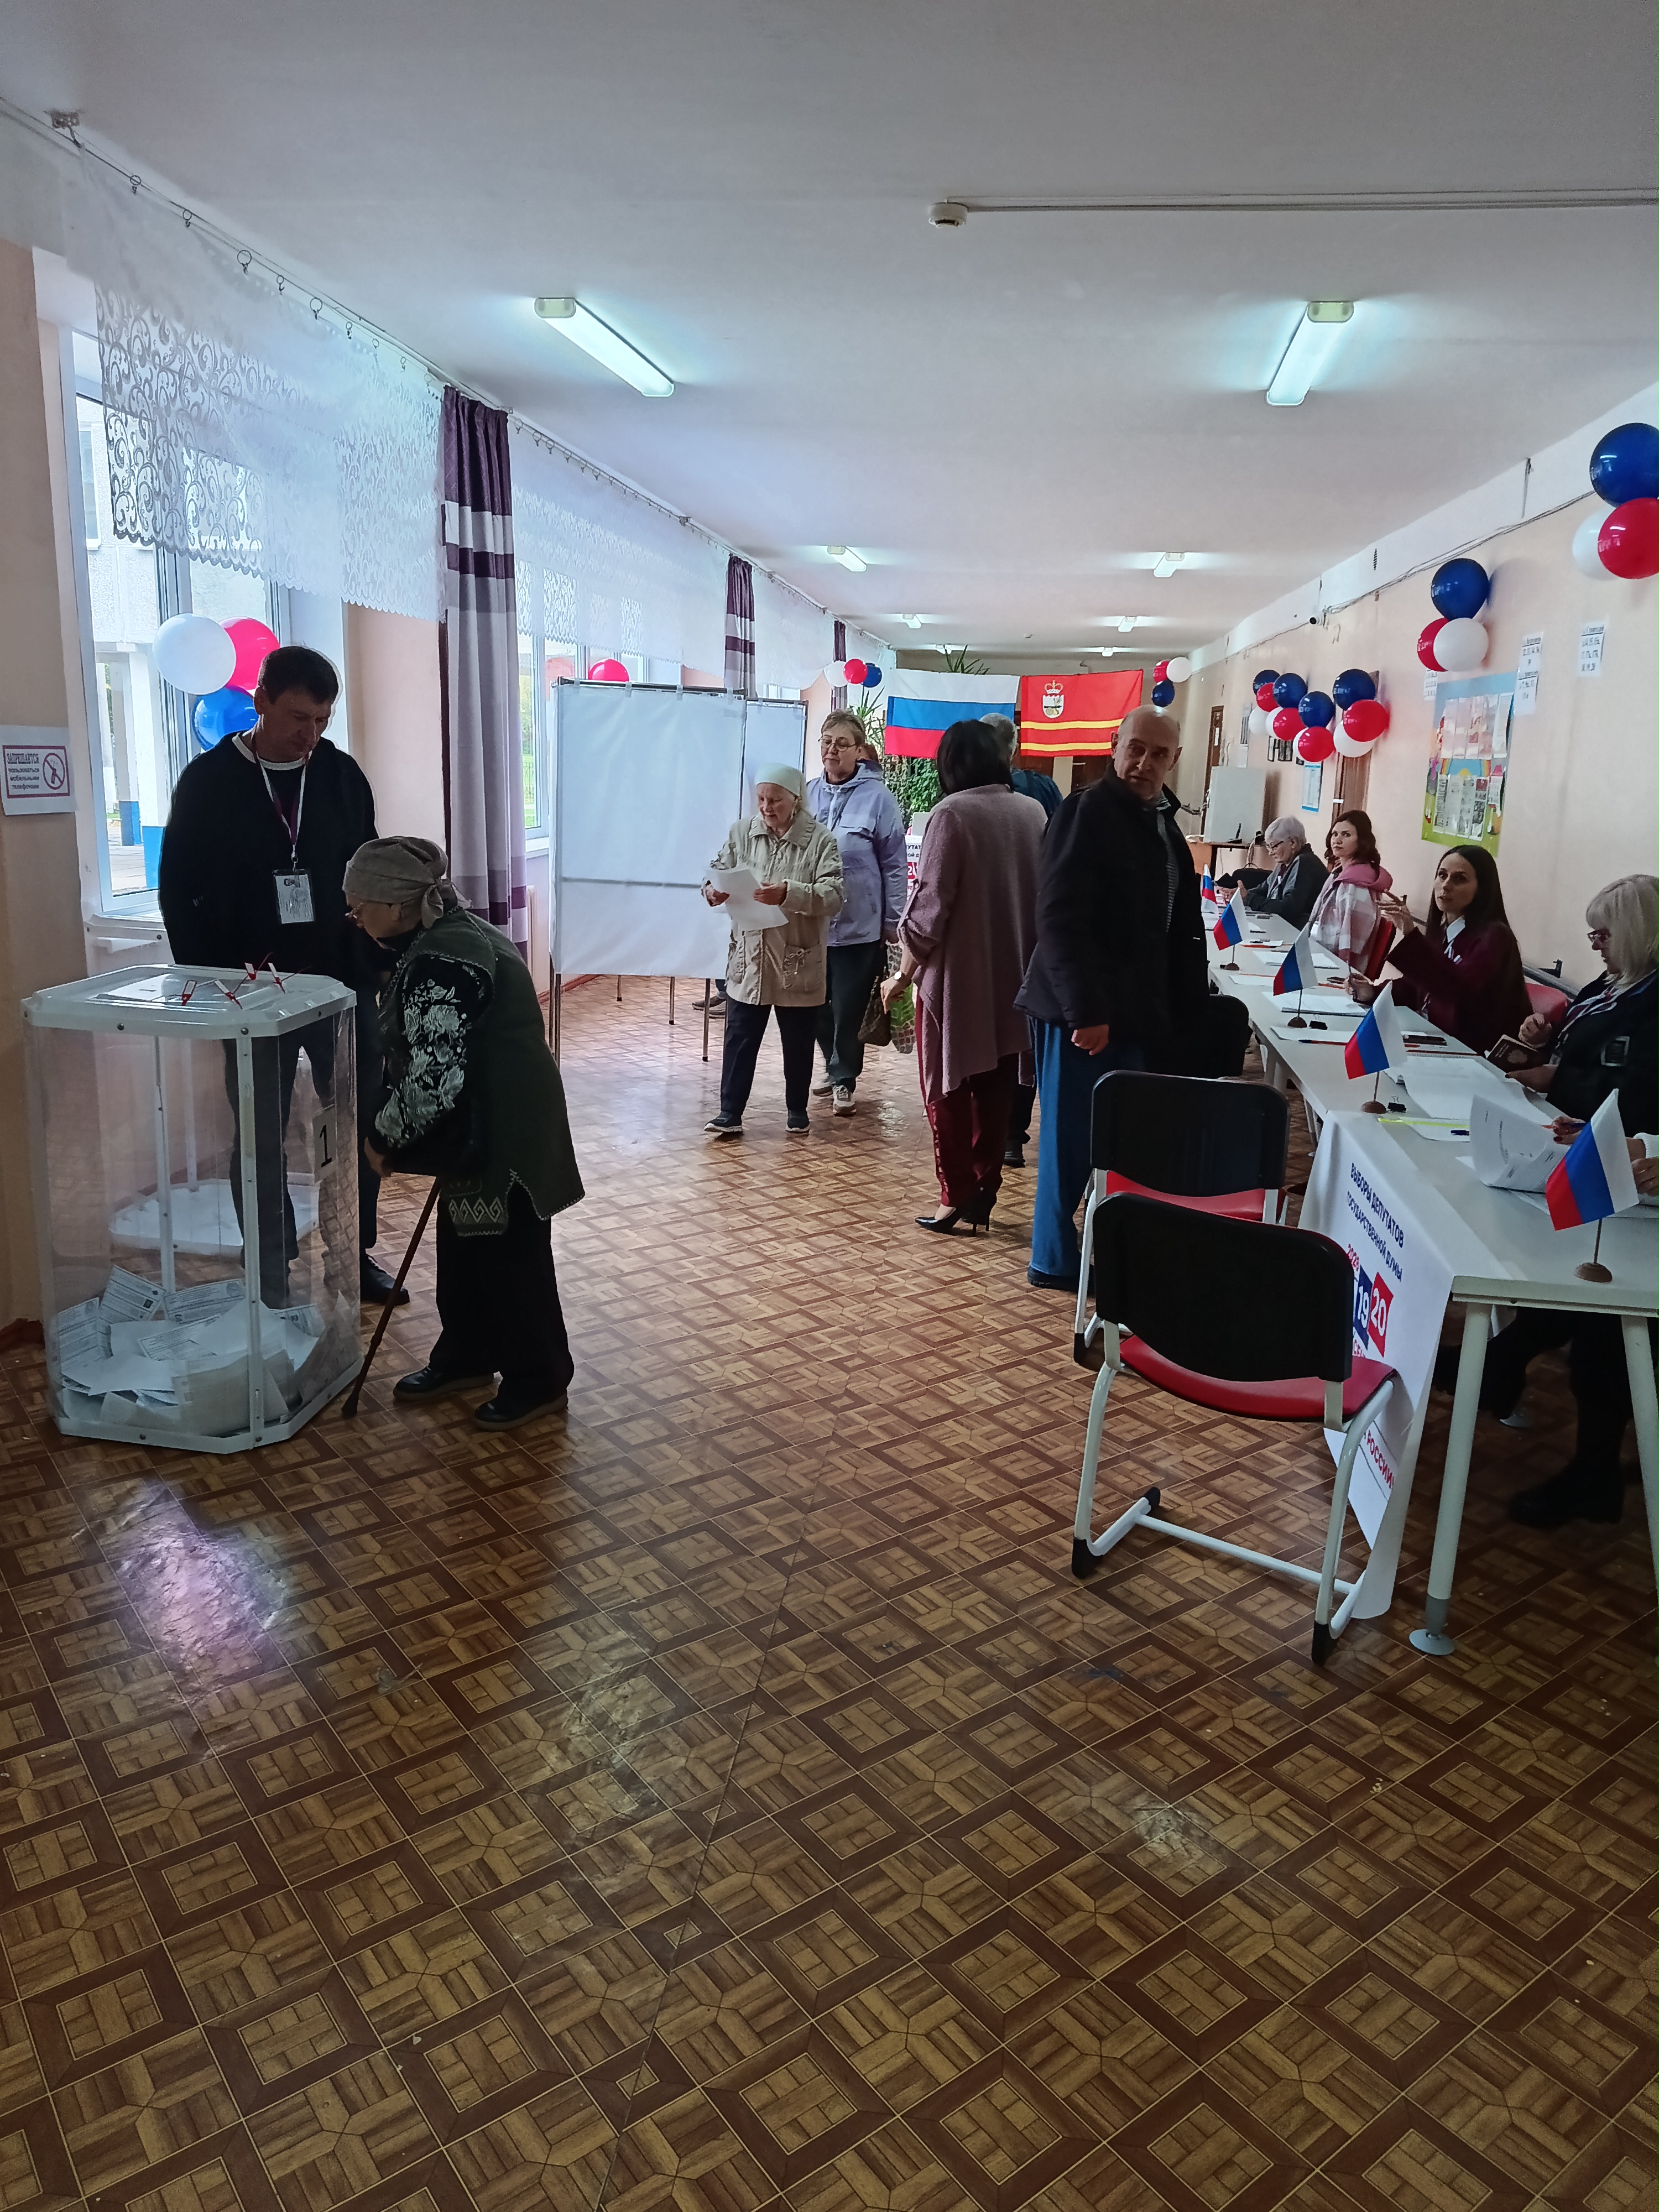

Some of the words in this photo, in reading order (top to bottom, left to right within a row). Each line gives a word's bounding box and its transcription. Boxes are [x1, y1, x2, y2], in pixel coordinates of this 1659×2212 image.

[319, 1124, 332, 1168] 1
[1350, 1162, 1372, 1203] ВЫБОРЫ
[1371, 1192, 1404, 1248] ДЕПУТАТОВ
[1358, 1285, 1370, 1328] 19
[1371, 1287, 1386, 1337] 20
